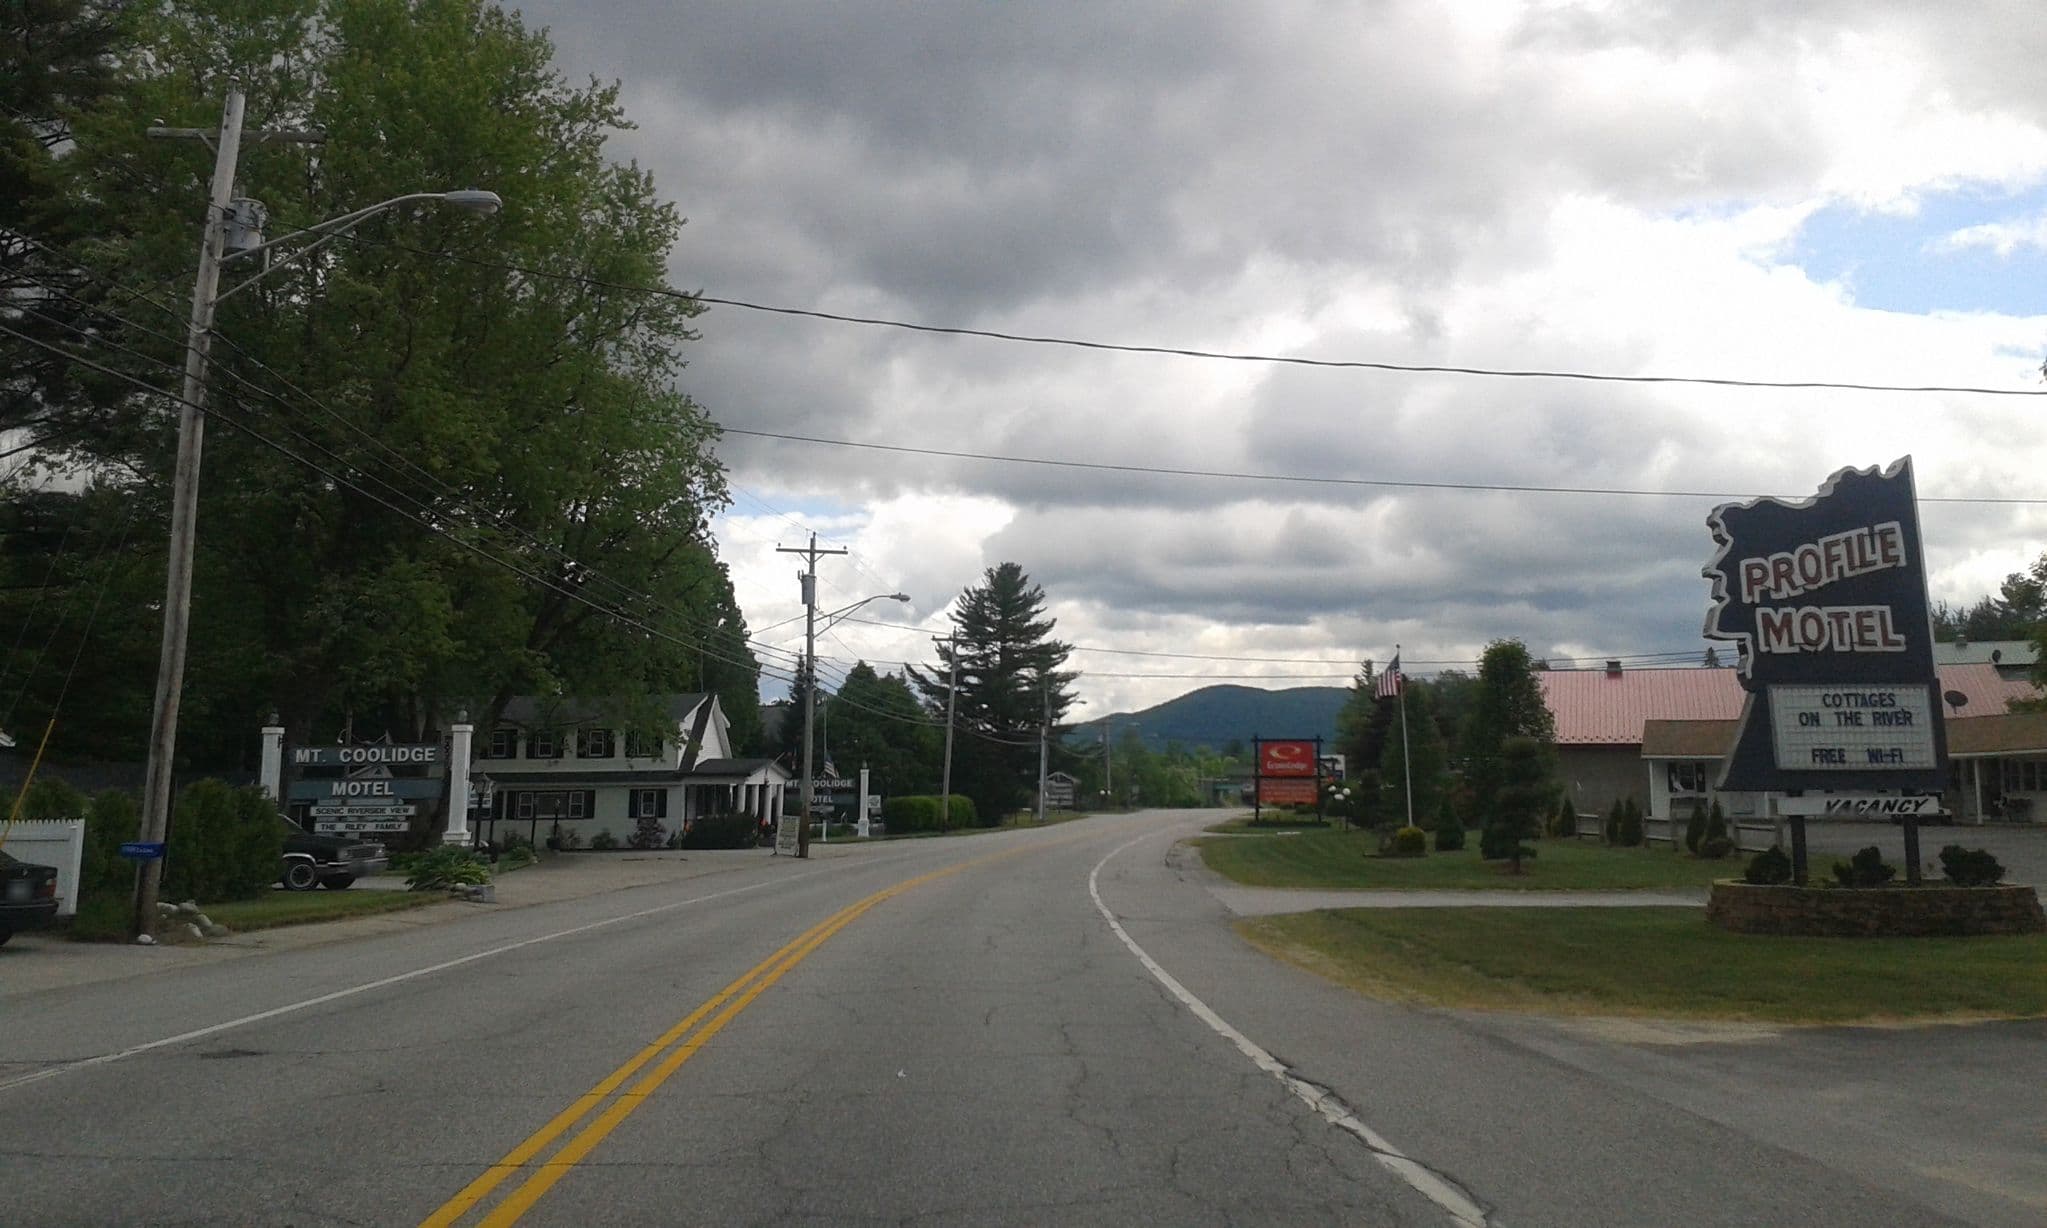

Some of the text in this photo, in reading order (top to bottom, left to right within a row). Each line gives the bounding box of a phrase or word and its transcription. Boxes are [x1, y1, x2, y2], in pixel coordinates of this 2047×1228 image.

[1741, 523, 1905, 602] PROFILE
[1757, 606, 1906, 651] MOTEL
[1822, 692, 1896, 708] COTTAGES
[1798, 709, 1913, 727] ON THE RIVER
[295, 747, 437, 763] MT. COOLIDGE
[1811, 747, 1905, 764] FREE WI-FI
[331, 781, 395, 796] MOTEL
[315, 807, 345, 815] SCENIC
[1824, 798, 1929, 815] VACANCY
[321, 823, 337, 831] THE
[374, 822, 402, 831] FAMILY
